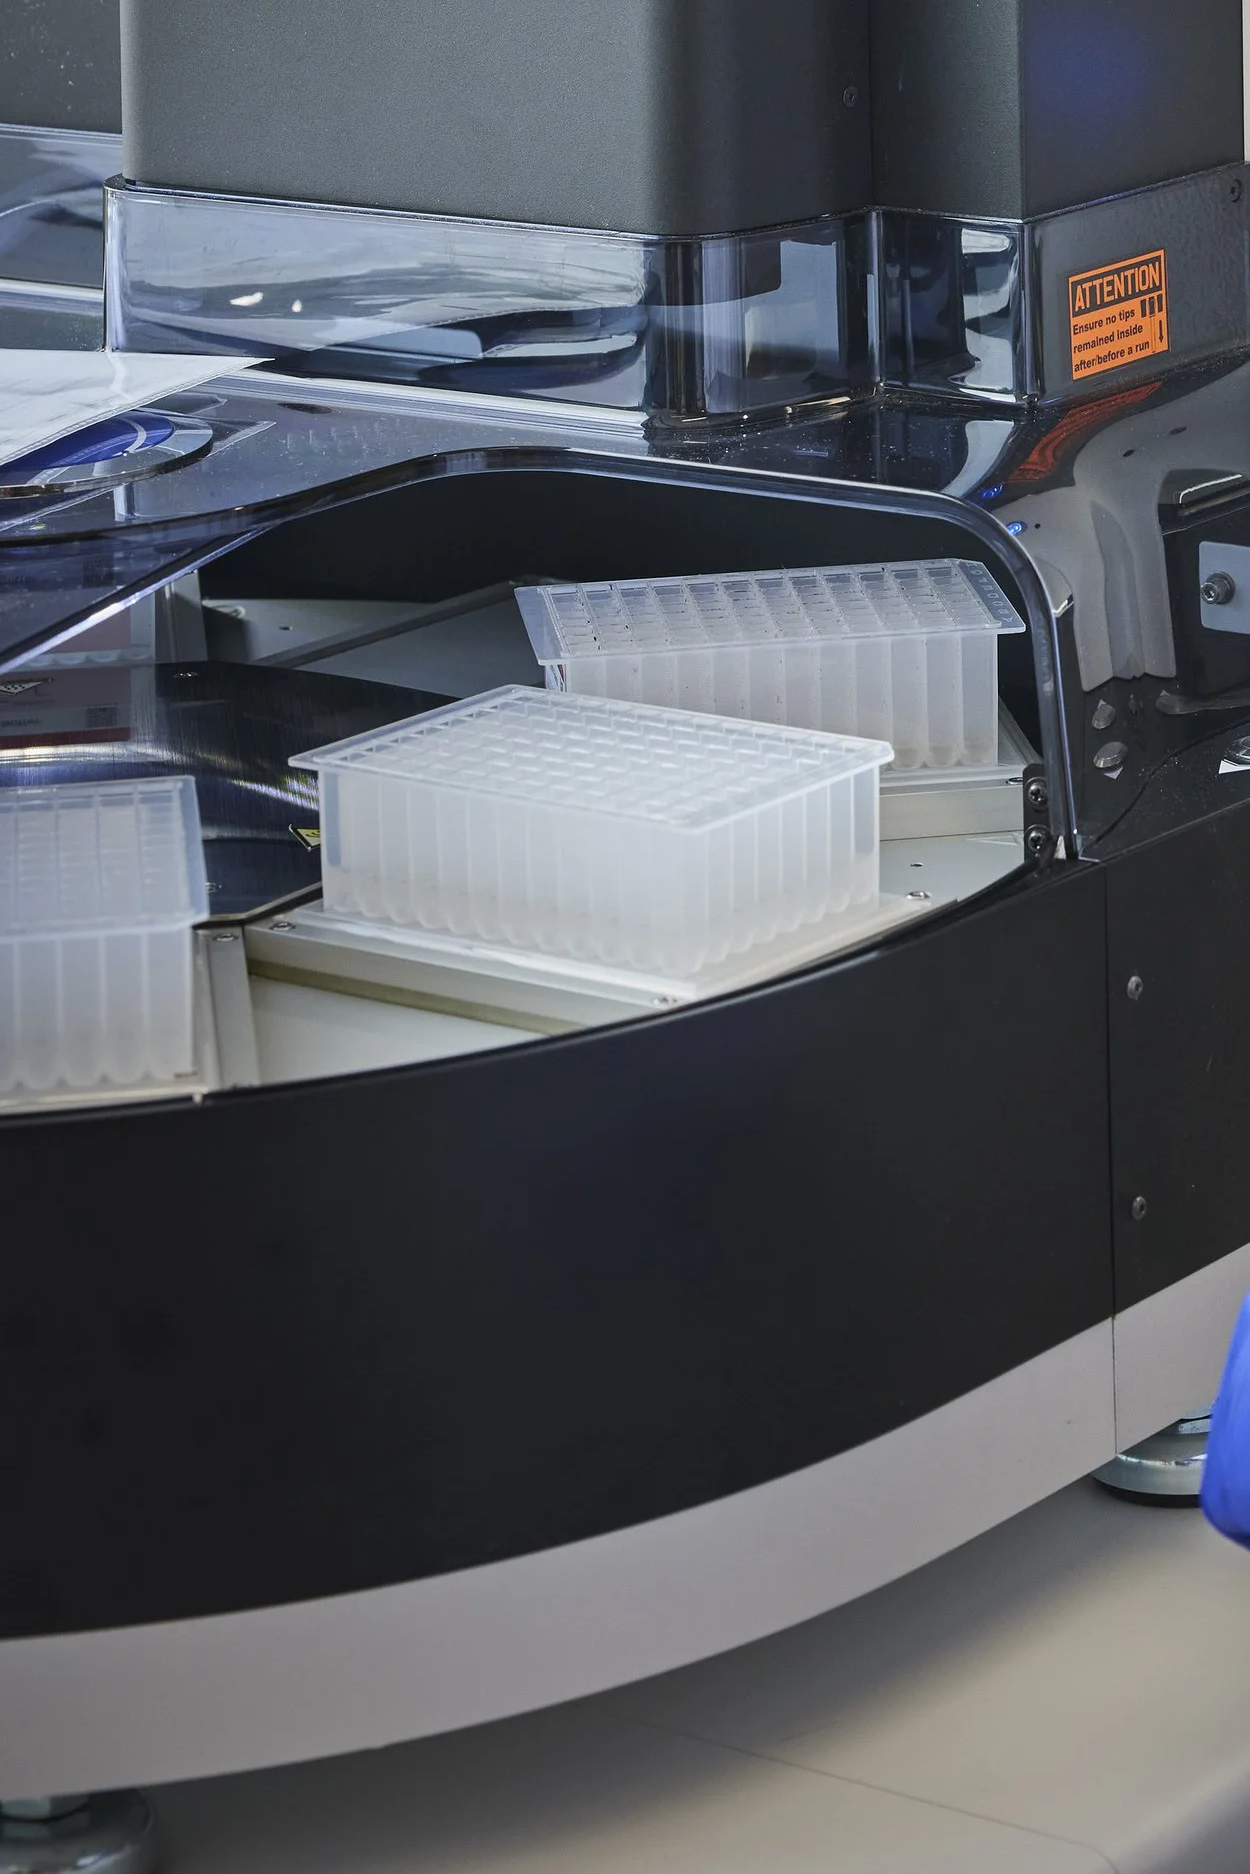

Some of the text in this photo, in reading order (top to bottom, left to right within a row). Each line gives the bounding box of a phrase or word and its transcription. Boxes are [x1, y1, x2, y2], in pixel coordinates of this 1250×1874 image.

[1075, 261, 1160, 312] ATTENTION
[1073, 309, 1135, 336] Ensure no tips
[1073, 324, 1143, 354] remained inside
[1127, 346, 1133, 355] a
[1135, 341, 1150, 353] run
